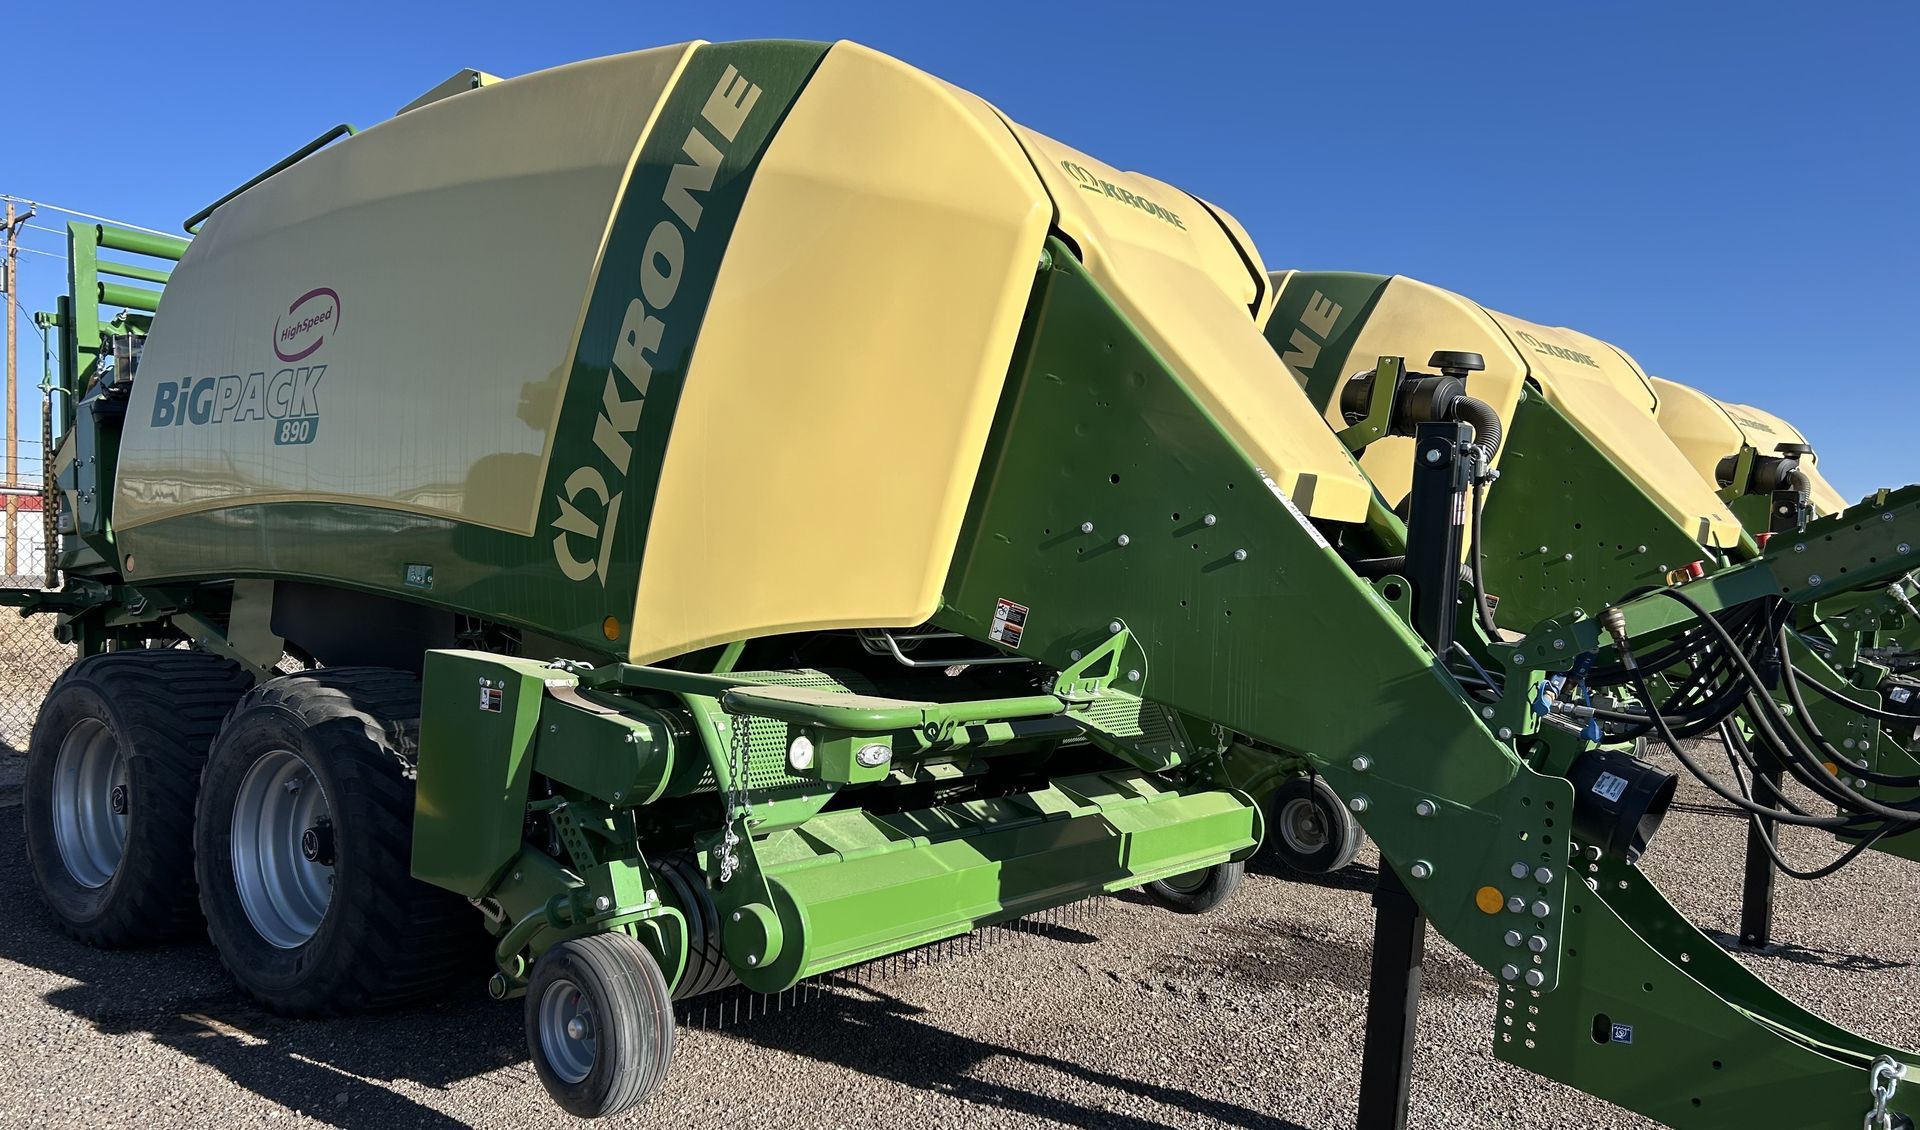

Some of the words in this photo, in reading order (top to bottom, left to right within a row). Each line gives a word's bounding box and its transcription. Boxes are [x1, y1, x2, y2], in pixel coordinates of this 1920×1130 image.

[1098, 179, 1187, 232] KRONE
[592, 64, 763, 477] KRONE
[280, 306, 333, 342] HighSpeed
[280, 420, 310, 443] 890
